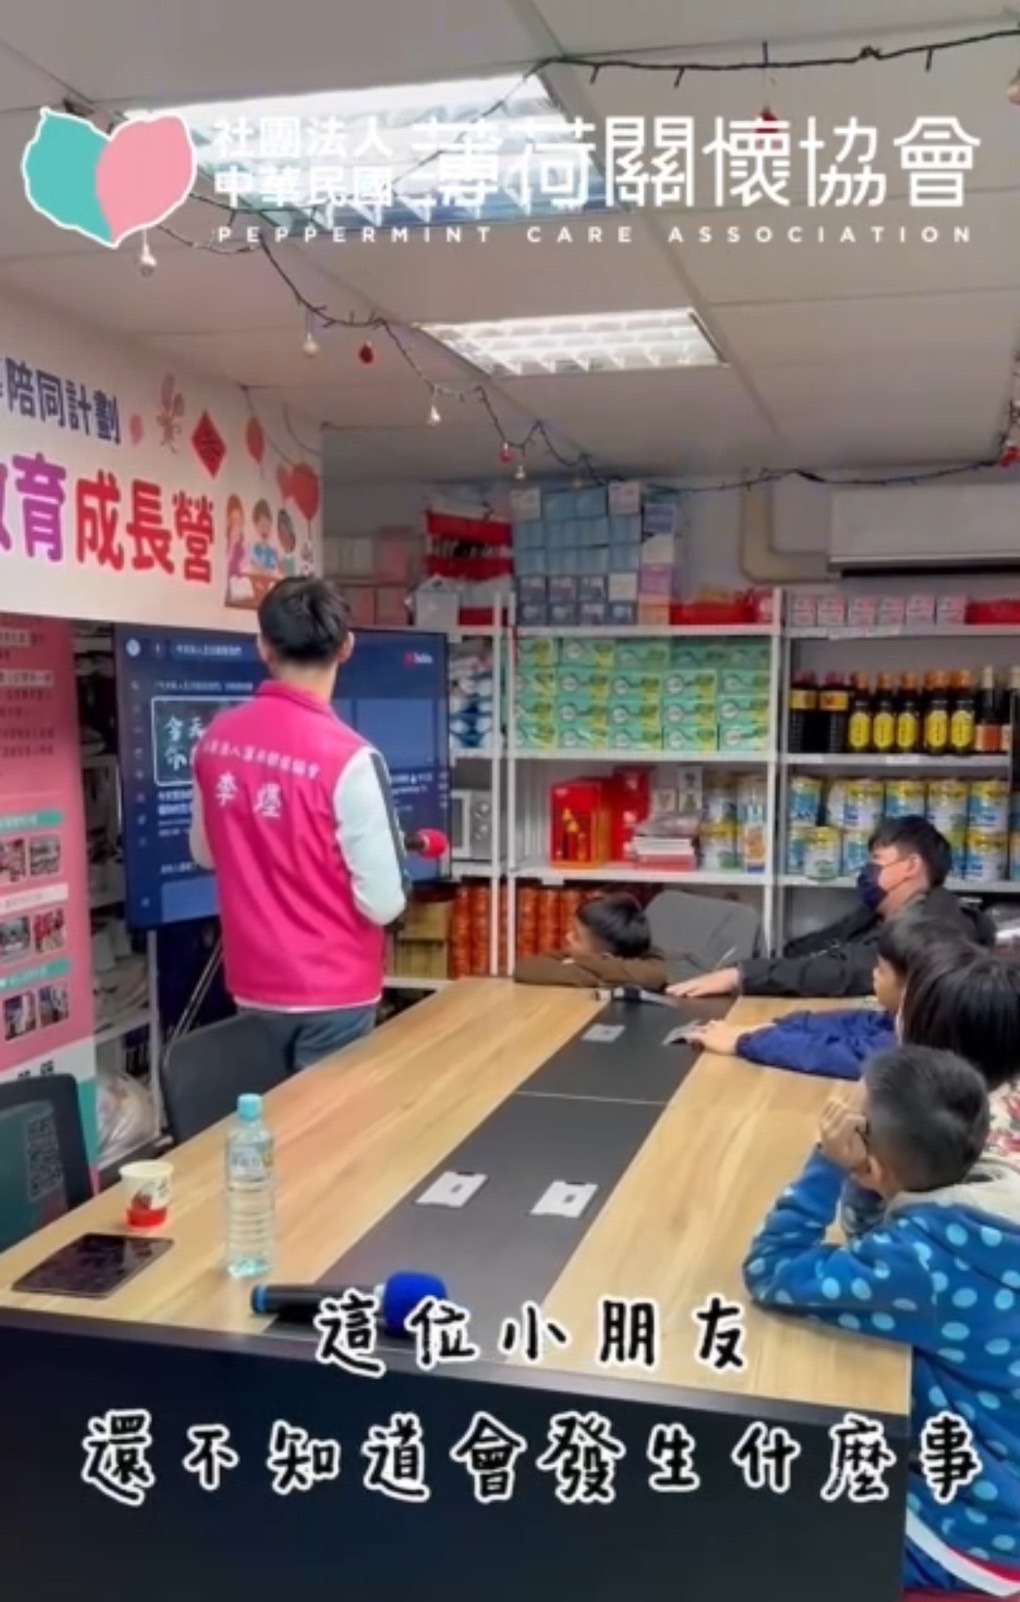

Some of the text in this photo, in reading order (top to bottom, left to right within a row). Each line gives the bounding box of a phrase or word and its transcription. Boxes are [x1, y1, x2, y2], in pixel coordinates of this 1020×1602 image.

[0, 356, 121, 445] 陪同計劃
[0, 452, 215, 583] 育成長營
